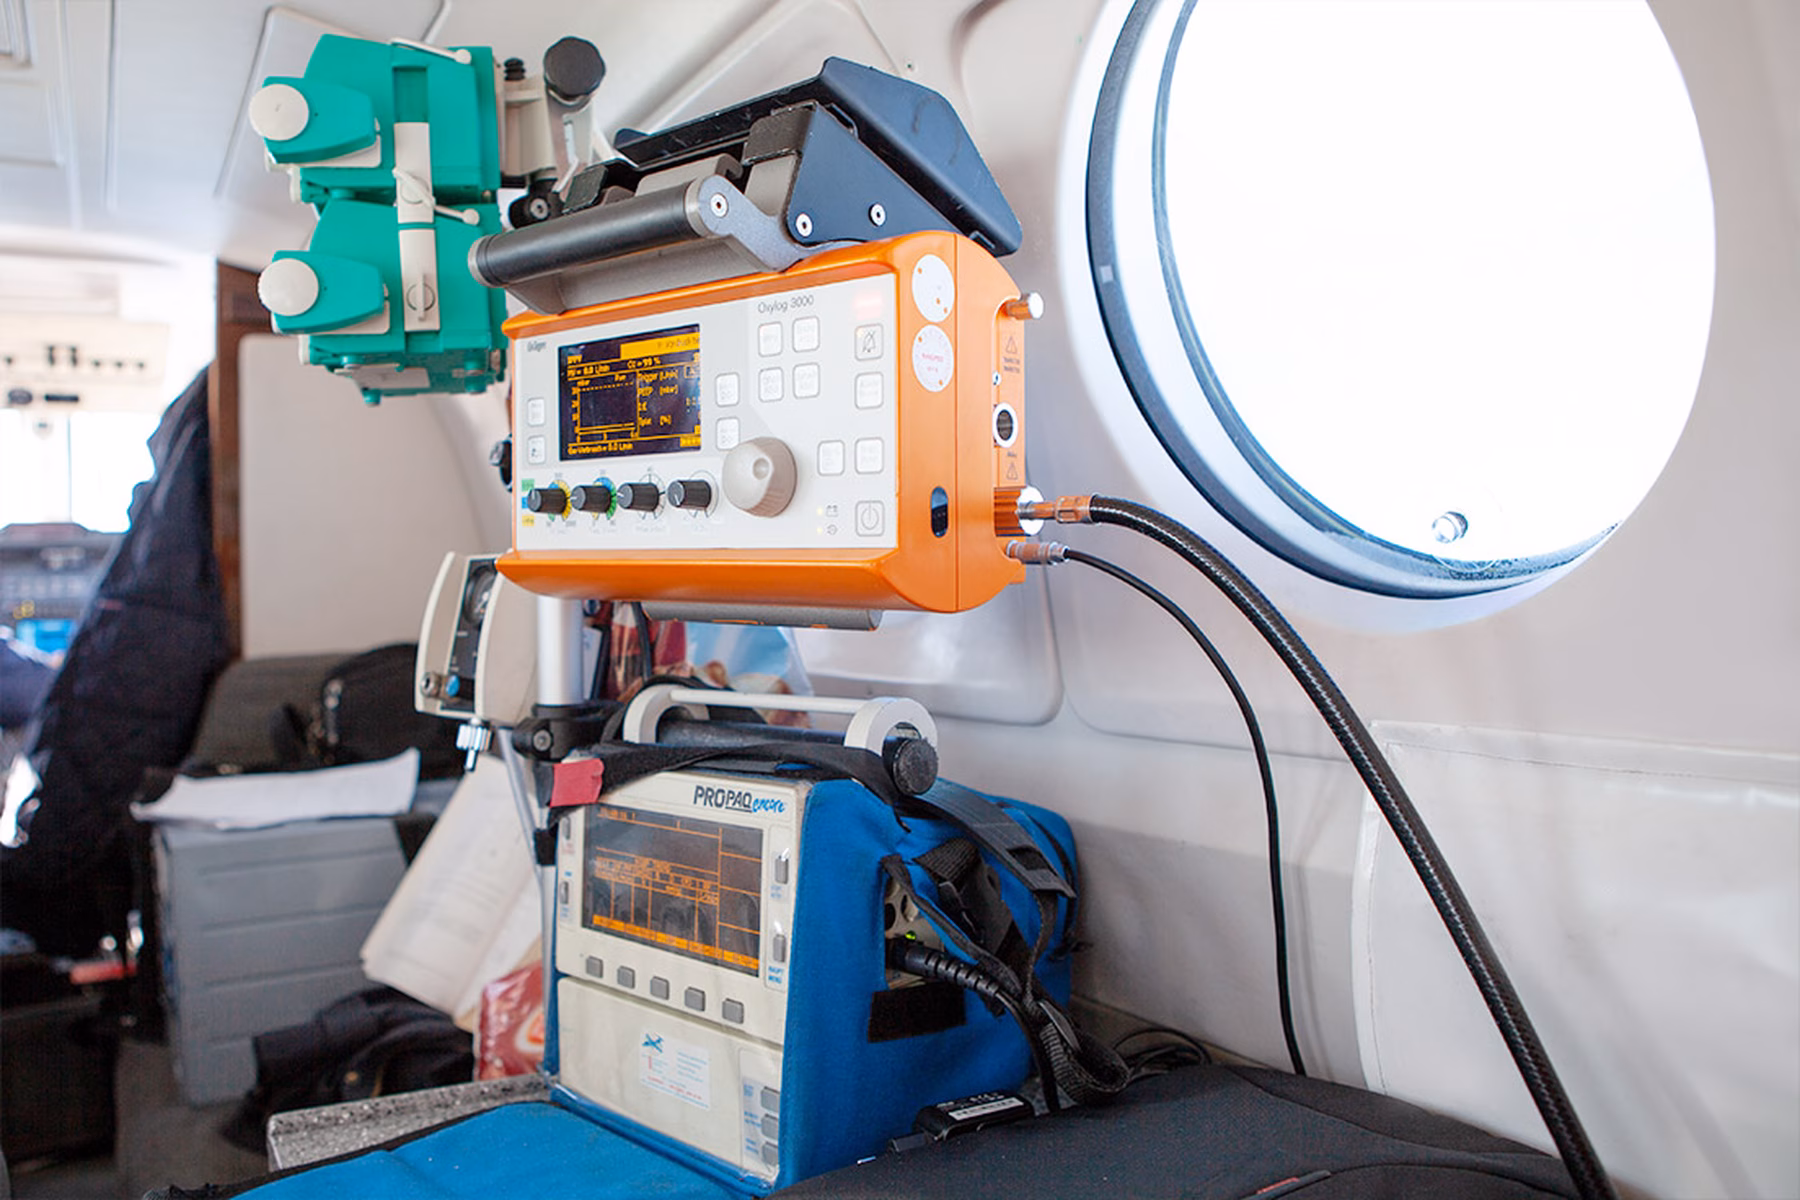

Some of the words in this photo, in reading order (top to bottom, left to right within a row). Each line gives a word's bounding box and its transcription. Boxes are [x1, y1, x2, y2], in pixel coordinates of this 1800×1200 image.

[757, 300, 788, 315] Oxylog
[790, 294, 815, 309] 3000
[693, 785, 752, 812] PROPAQ
